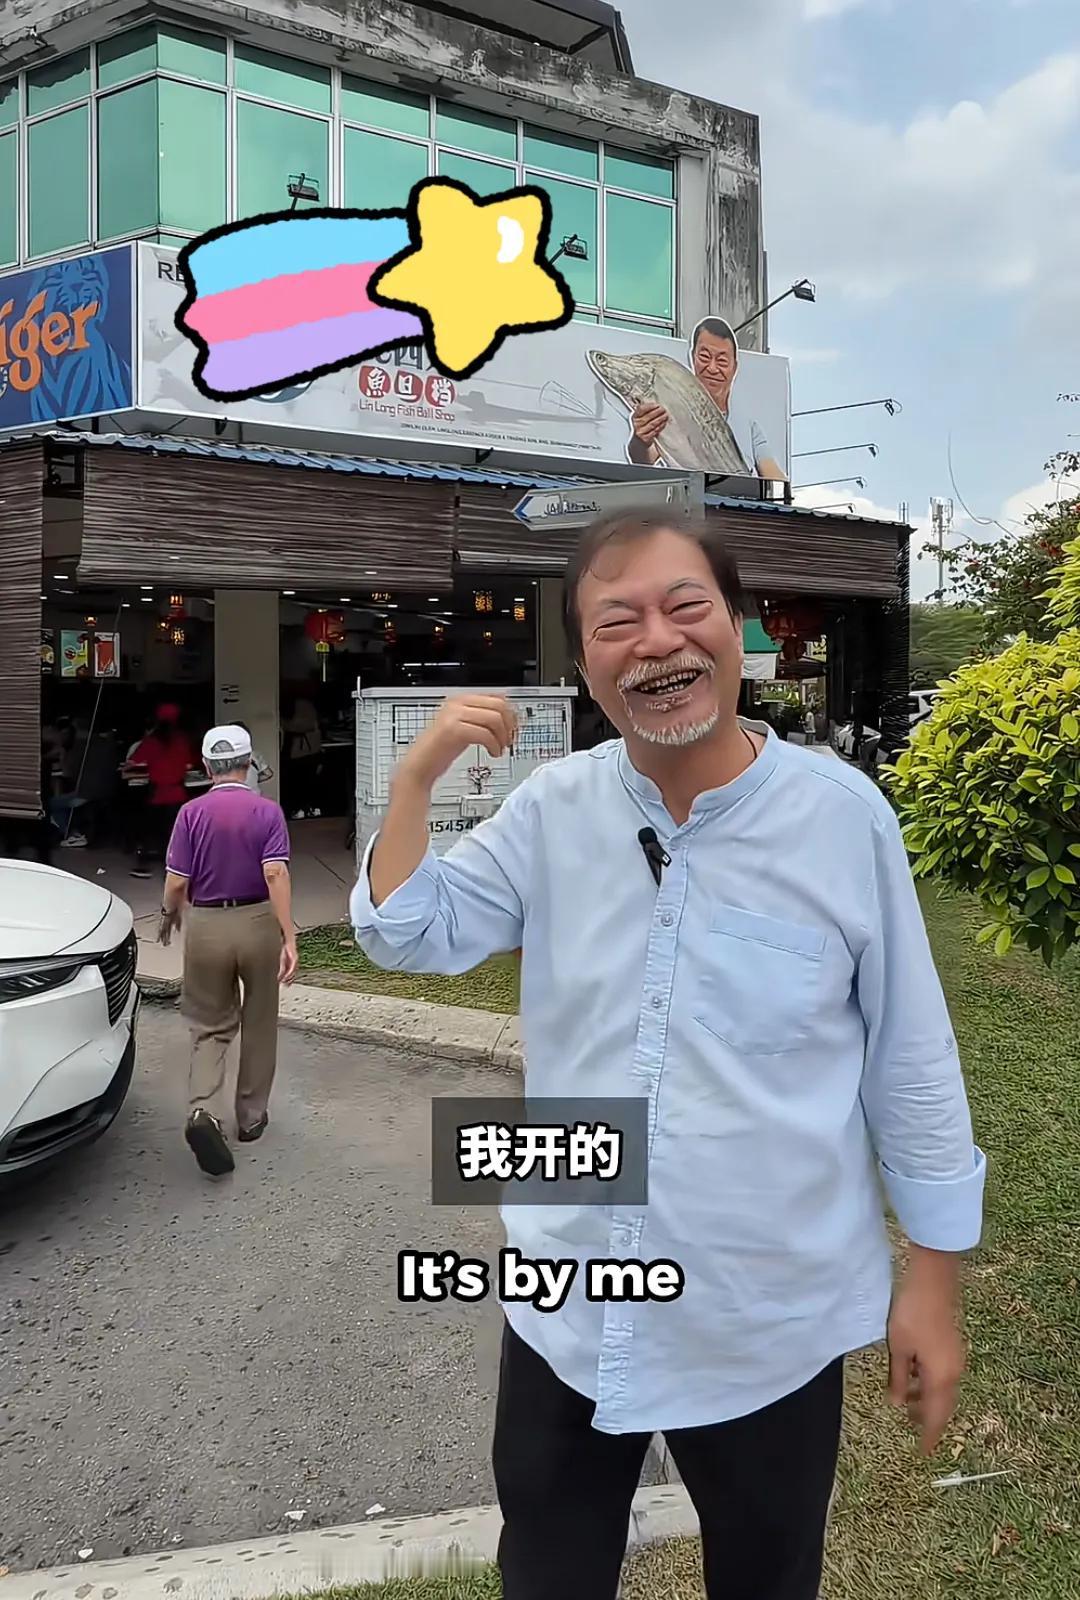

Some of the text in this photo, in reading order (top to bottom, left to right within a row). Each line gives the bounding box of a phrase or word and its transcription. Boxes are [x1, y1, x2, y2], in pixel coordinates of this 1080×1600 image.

[359, 399, 373, 411] Lin
[375, 400, 396, 417] Long
[397, 404, 415, 416] Fish
[417, 406, 433, 419] Ball
